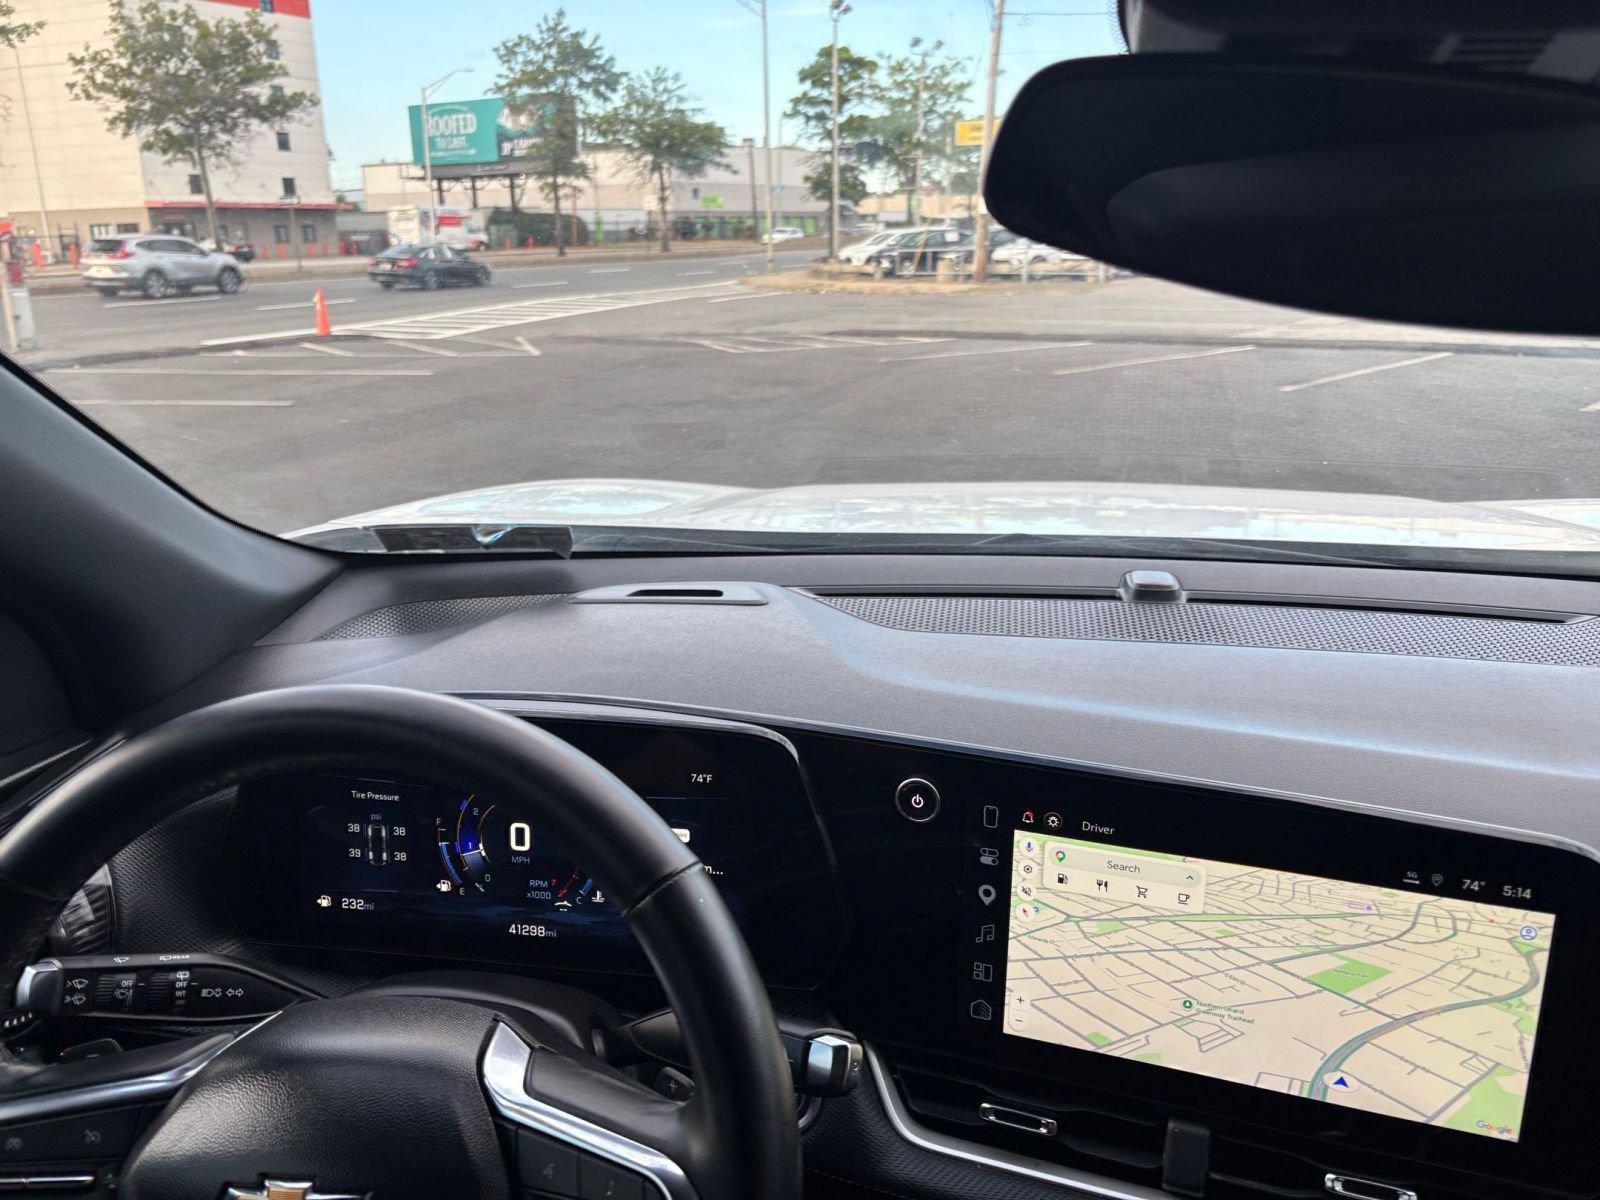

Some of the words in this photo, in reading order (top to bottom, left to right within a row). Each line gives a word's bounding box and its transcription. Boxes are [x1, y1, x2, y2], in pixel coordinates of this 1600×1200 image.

[691, 774, 713, 784] 74°F
[351, 791, 366, 800] Tire
[367, 792, 400, 802] Pressure
[370, 813, 383, 821] psi
[473, 808, 479, 816] 2
[348, 823, 361, 833] 38
[393, 827, 406, 837] 38
[1082, 821, 1115, 835] Driver
[510, 823, 531, 852] 0
[349, 848, 361, 858] 39
[394, 852, 407, 862] 38
[512, 856, 531, 864] MPH
[1106, 860, 1141, 874] Search
[530, 880, 548, 889] RPM
[460, 888, 466, 896] E
[527, 891, 552, 900] x1000
[1503, 886, 1532, 900] 5:14
[576, 897, 583, 905] C
[121, 980, 133, 988] OFF
[175, 981, 188, 989] OFF
[1476, 1119, 1513, 1136] Google
